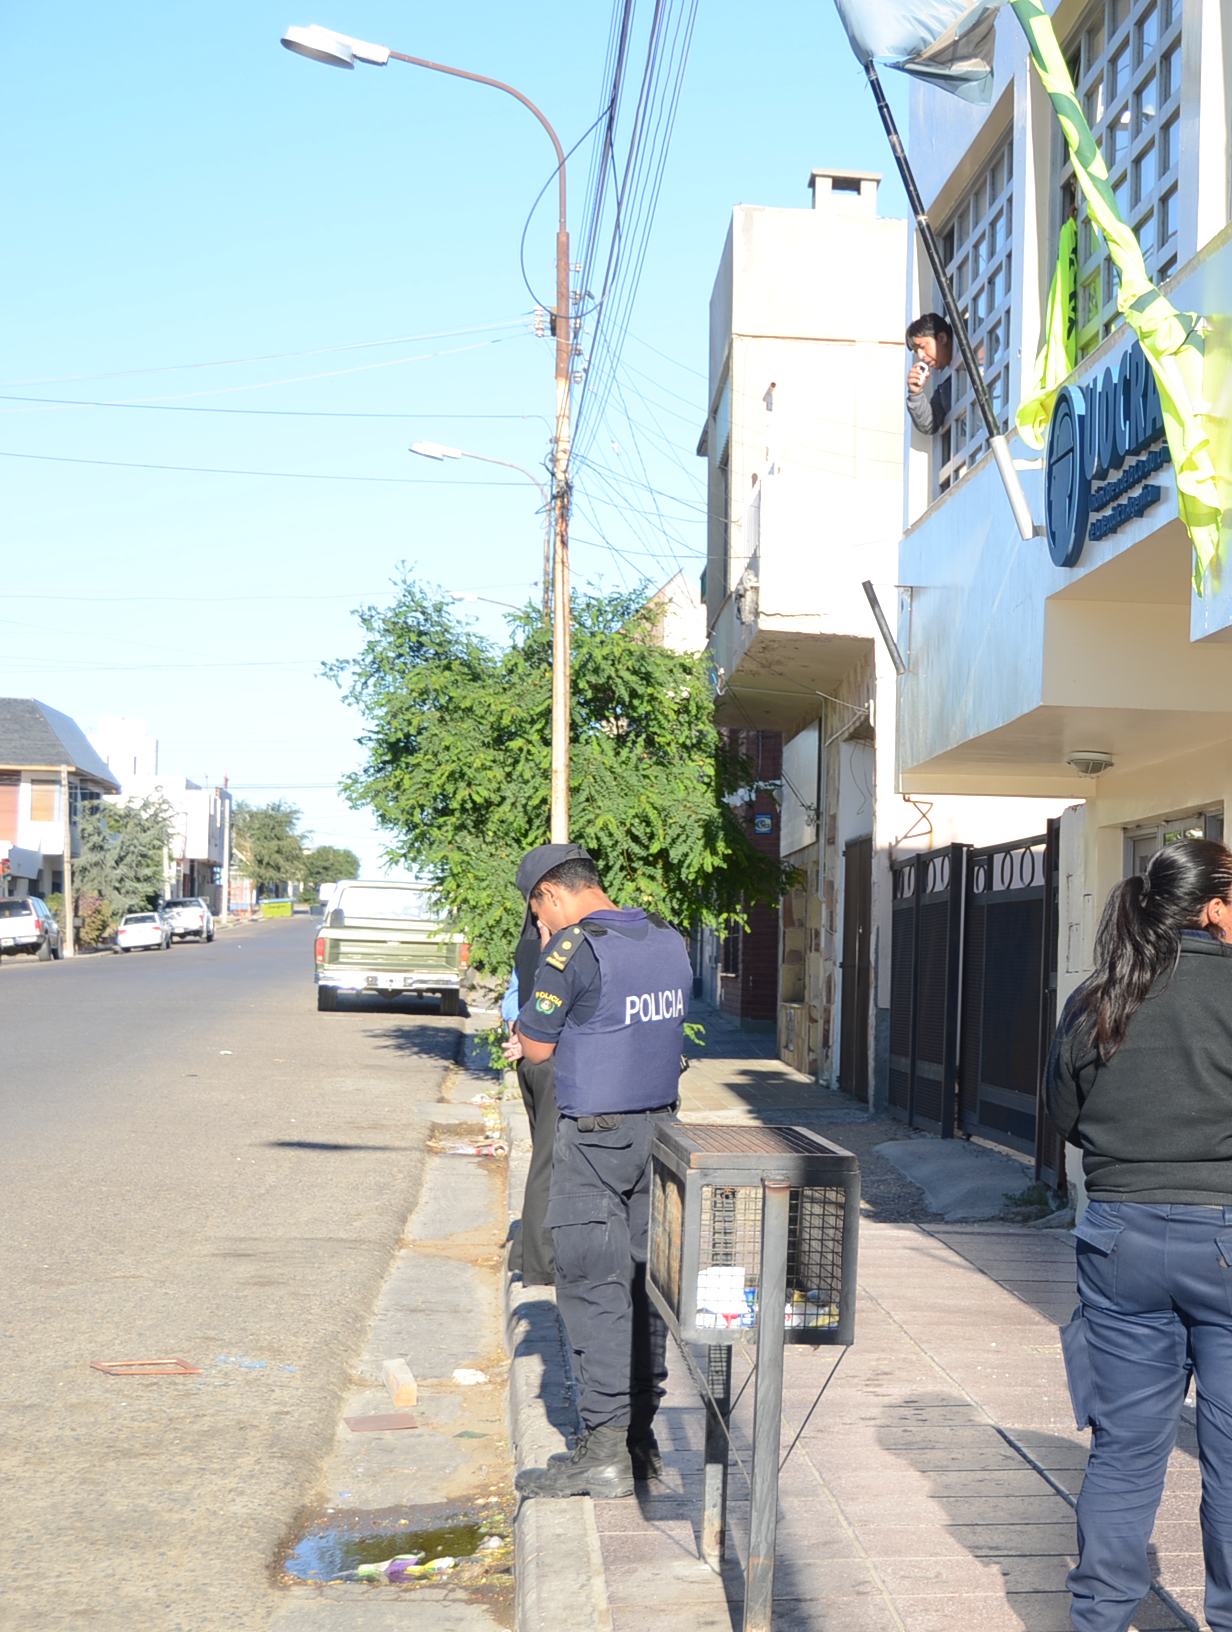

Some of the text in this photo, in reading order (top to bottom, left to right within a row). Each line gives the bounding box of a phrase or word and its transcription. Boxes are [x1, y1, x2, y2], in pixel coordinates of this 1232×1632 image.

[1083, 339, 1166, 481] UOCRA
[535, 991, 563, 1008] POLICIA
[625, 989, 685, 1024] POLICIA
